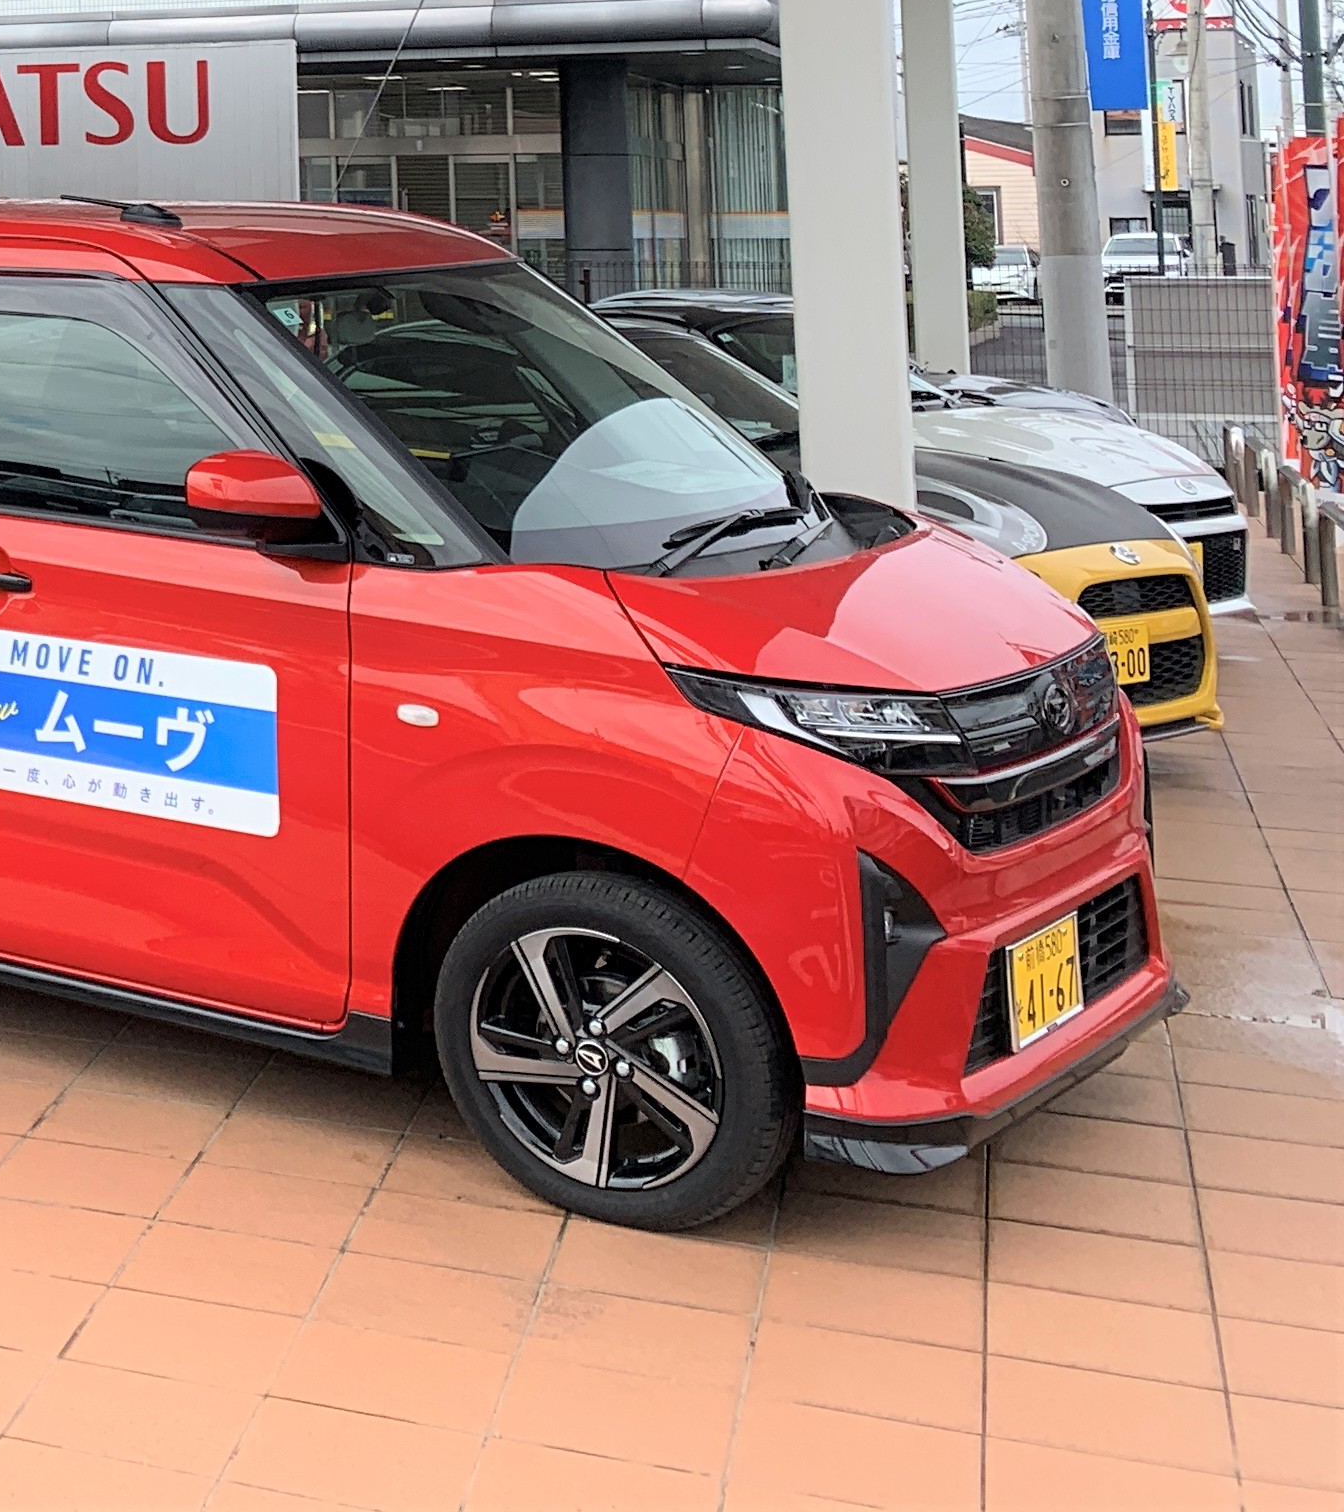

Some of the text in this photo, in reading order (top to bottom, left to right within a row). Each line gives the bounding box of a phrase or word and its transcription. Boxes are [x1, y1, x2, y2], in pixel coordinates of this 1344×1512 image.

[10, 639, 165, 687] MOVE ON.
[35, 689, 215, 773] ムーヴ
[1027, 955, 1074, 1030] 41-67
